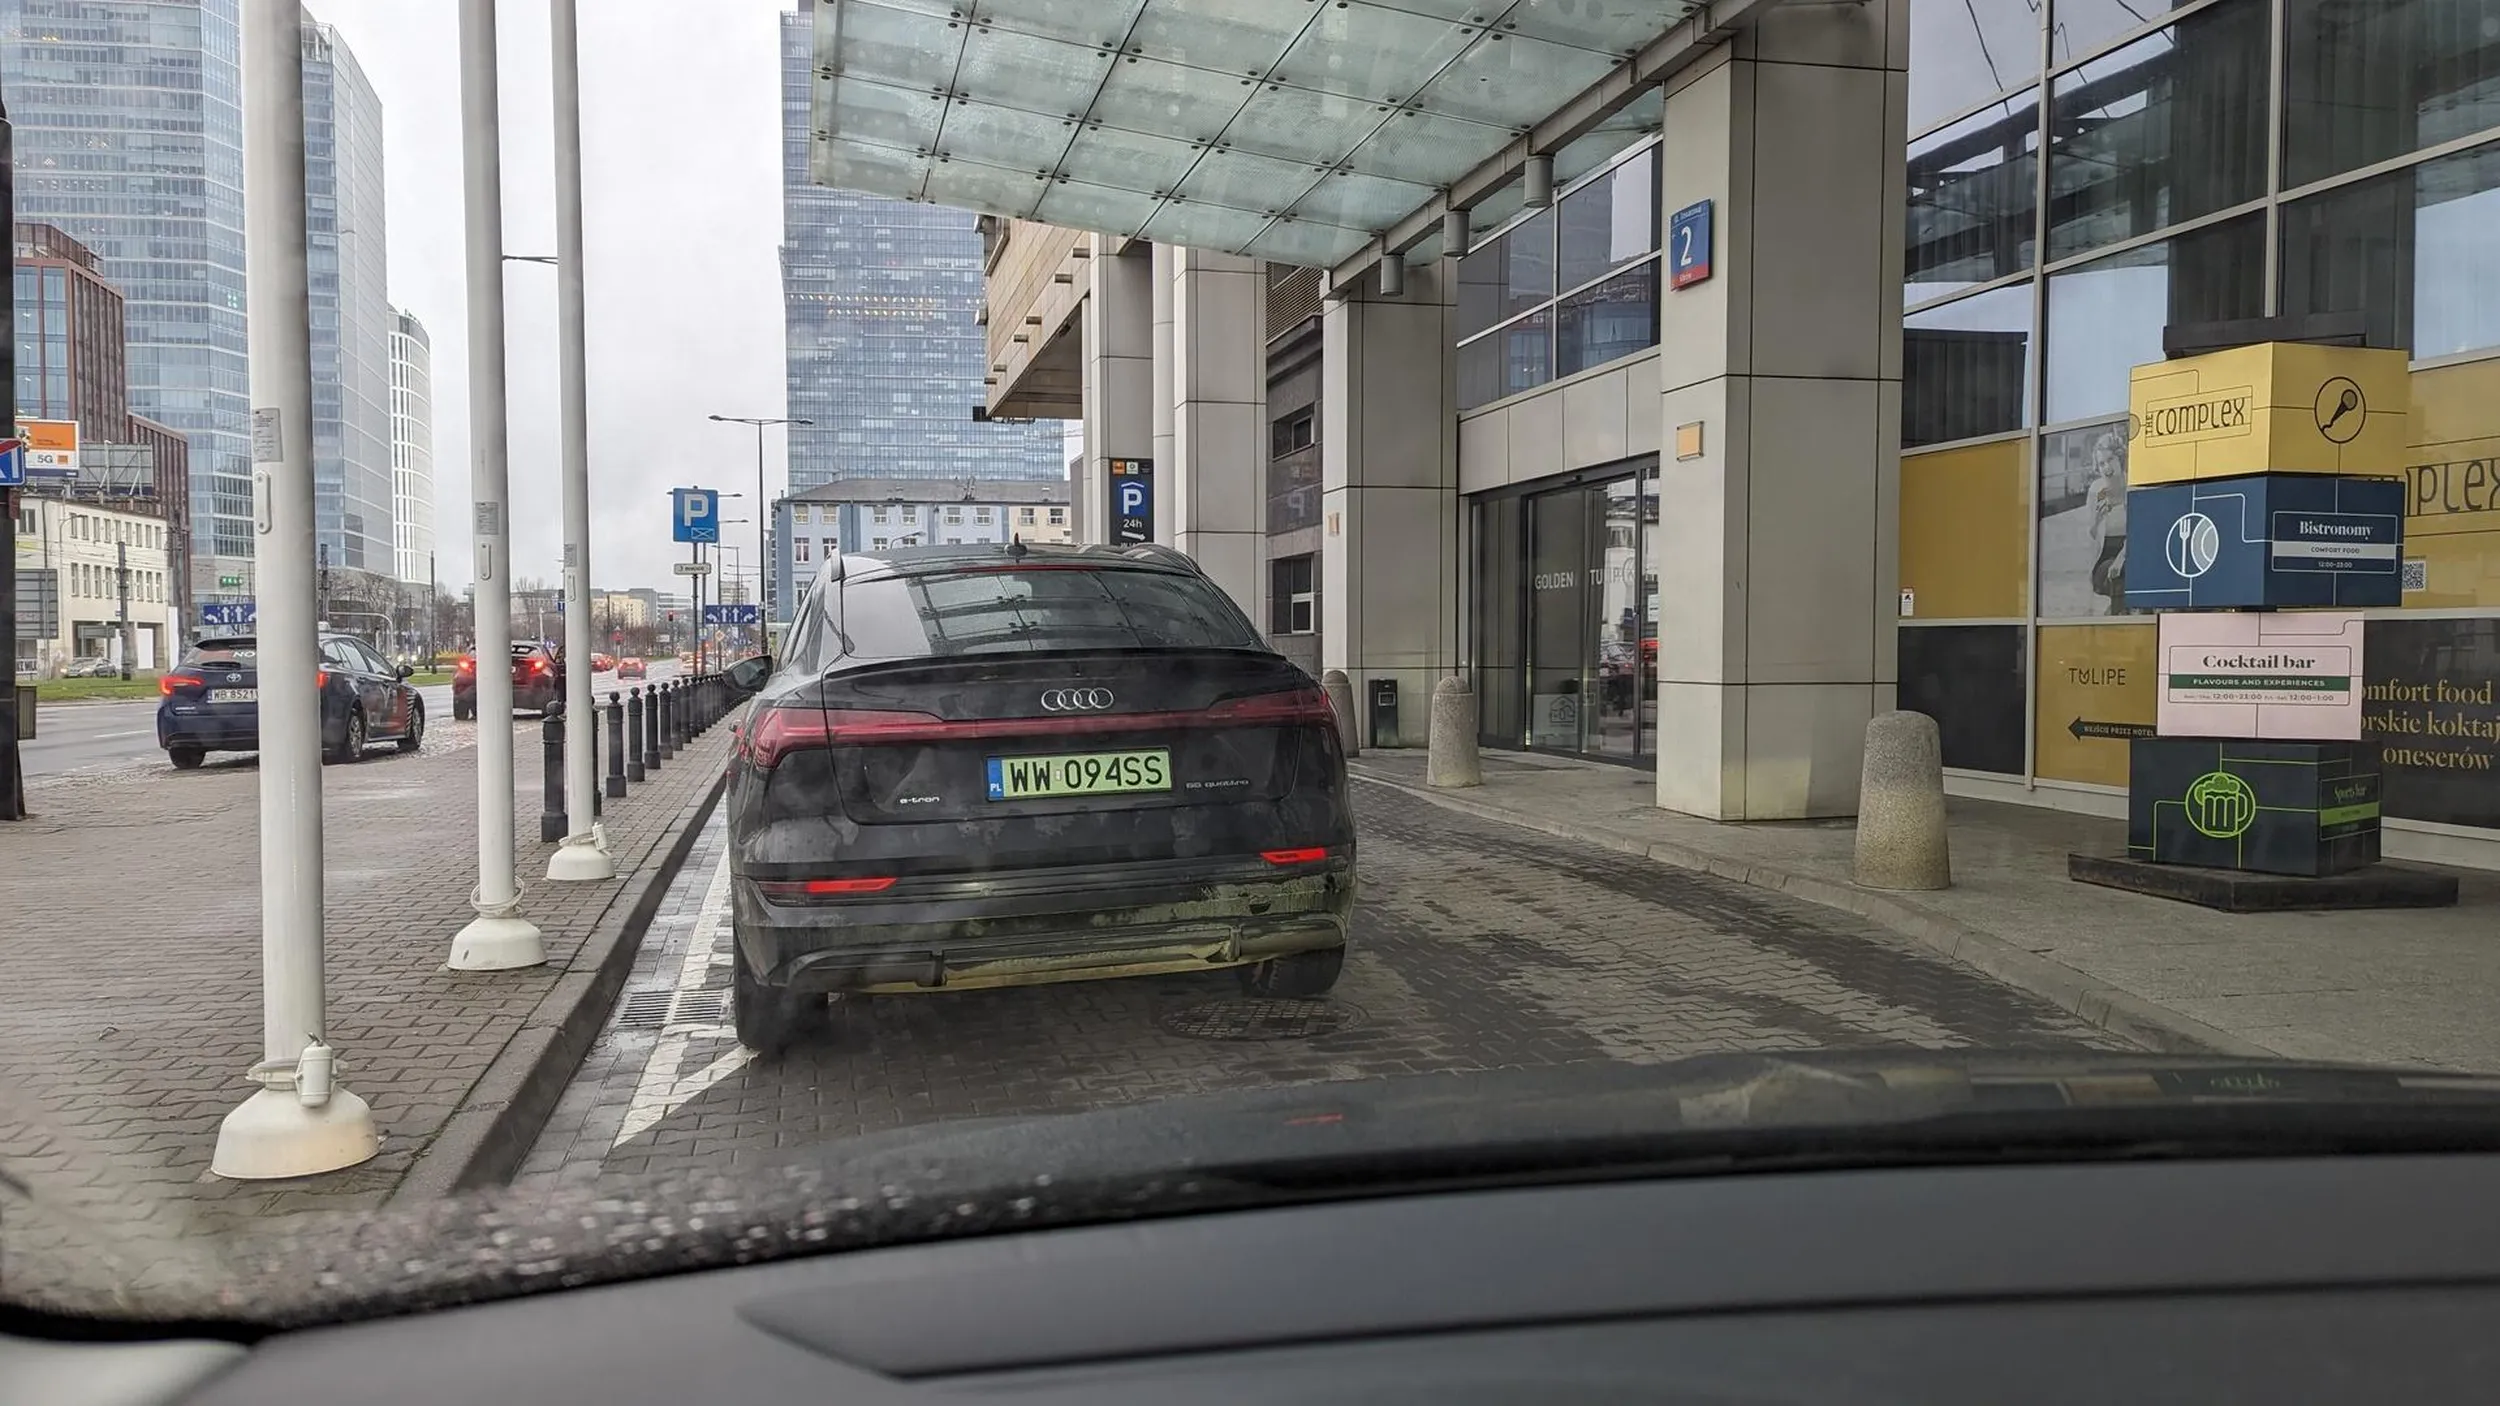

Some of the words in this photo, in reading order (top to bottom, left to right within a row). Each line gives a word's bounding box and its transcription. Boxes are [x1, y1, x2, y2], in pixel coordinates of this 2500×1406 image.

[1680, 225, 1692, 267] 2
[2145, 413, 2153, 435] THE
[37, 454, 53, 463] 5G
[684, 493, 709, 526] P
[1123, 488, 1143, 515] P
[1123, 518, 1143, 528] 24h
[2299, 520, 2374, 540] Bistronomy
[1534, 571, 1575, 590] GOLDEN
[2202, 655, 2279, 669] Cocktail
[2283, 655, 2316, 669] bar
[2068, 667, 2127, 686] TULIPE
[2193, 678, 2240, 686] FLAVOURS
[2263, 679, 2326, 687] EXPERIENCES
[2437, 679, 2493, 705] food
[1010, 761, 1051, 793] WW
[1064, 755, 1163, 790] 094SS
[990, 782, 1003, 792] PL
